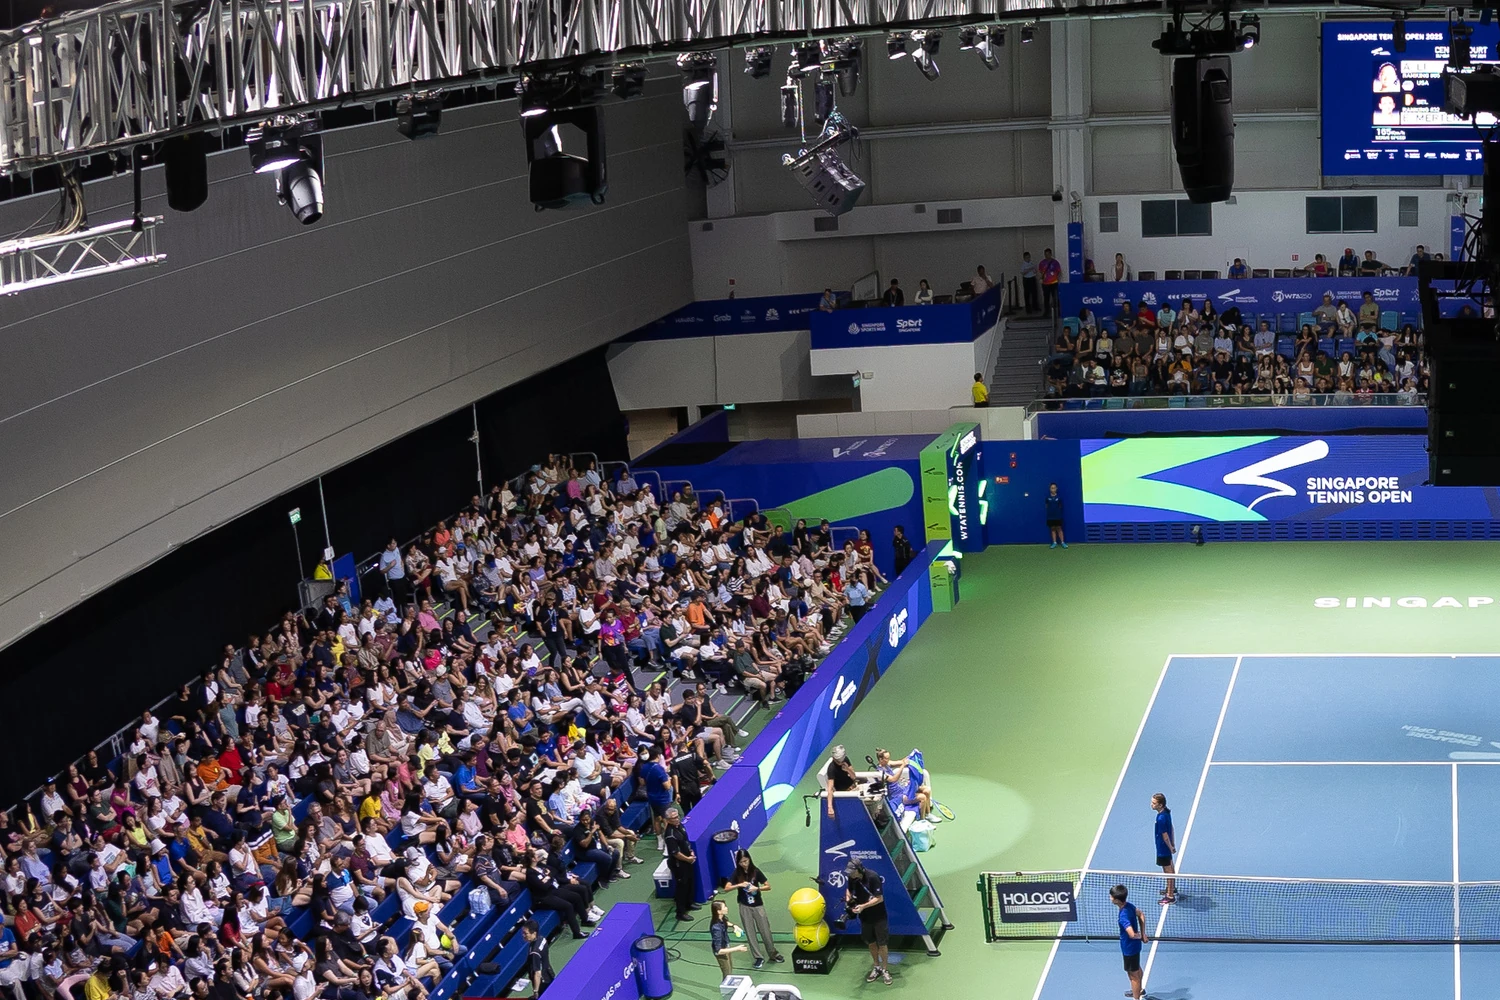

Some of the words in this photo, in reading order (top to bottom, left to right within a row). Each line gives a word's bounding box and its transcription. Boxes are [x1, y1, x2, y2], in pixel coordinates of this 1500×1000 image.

[1404, 33, 1424, 41] OPEN
[1373, 288, 1400, 298] Sport
[1082, 296, 1103, 304] Grab
[713, 314, 732, 322] Grab
[896, 318, 923, 329] Sport
[1307, 477, 1399, 490] SINGAPORE
[957, 462, 968, 540] WTATENNIS.COM
[1307, 490, 1365, 503] TENNIS
[1369, 490, 1412, 503] OPEN
[1401, 724, 1437, 734] OPEN
[1438, 729, 1483, 742] TENNIS
[1405, 731, 1481, 746] SINGAPORE
[1003, 892, 1070, 905] HOLOGIC
